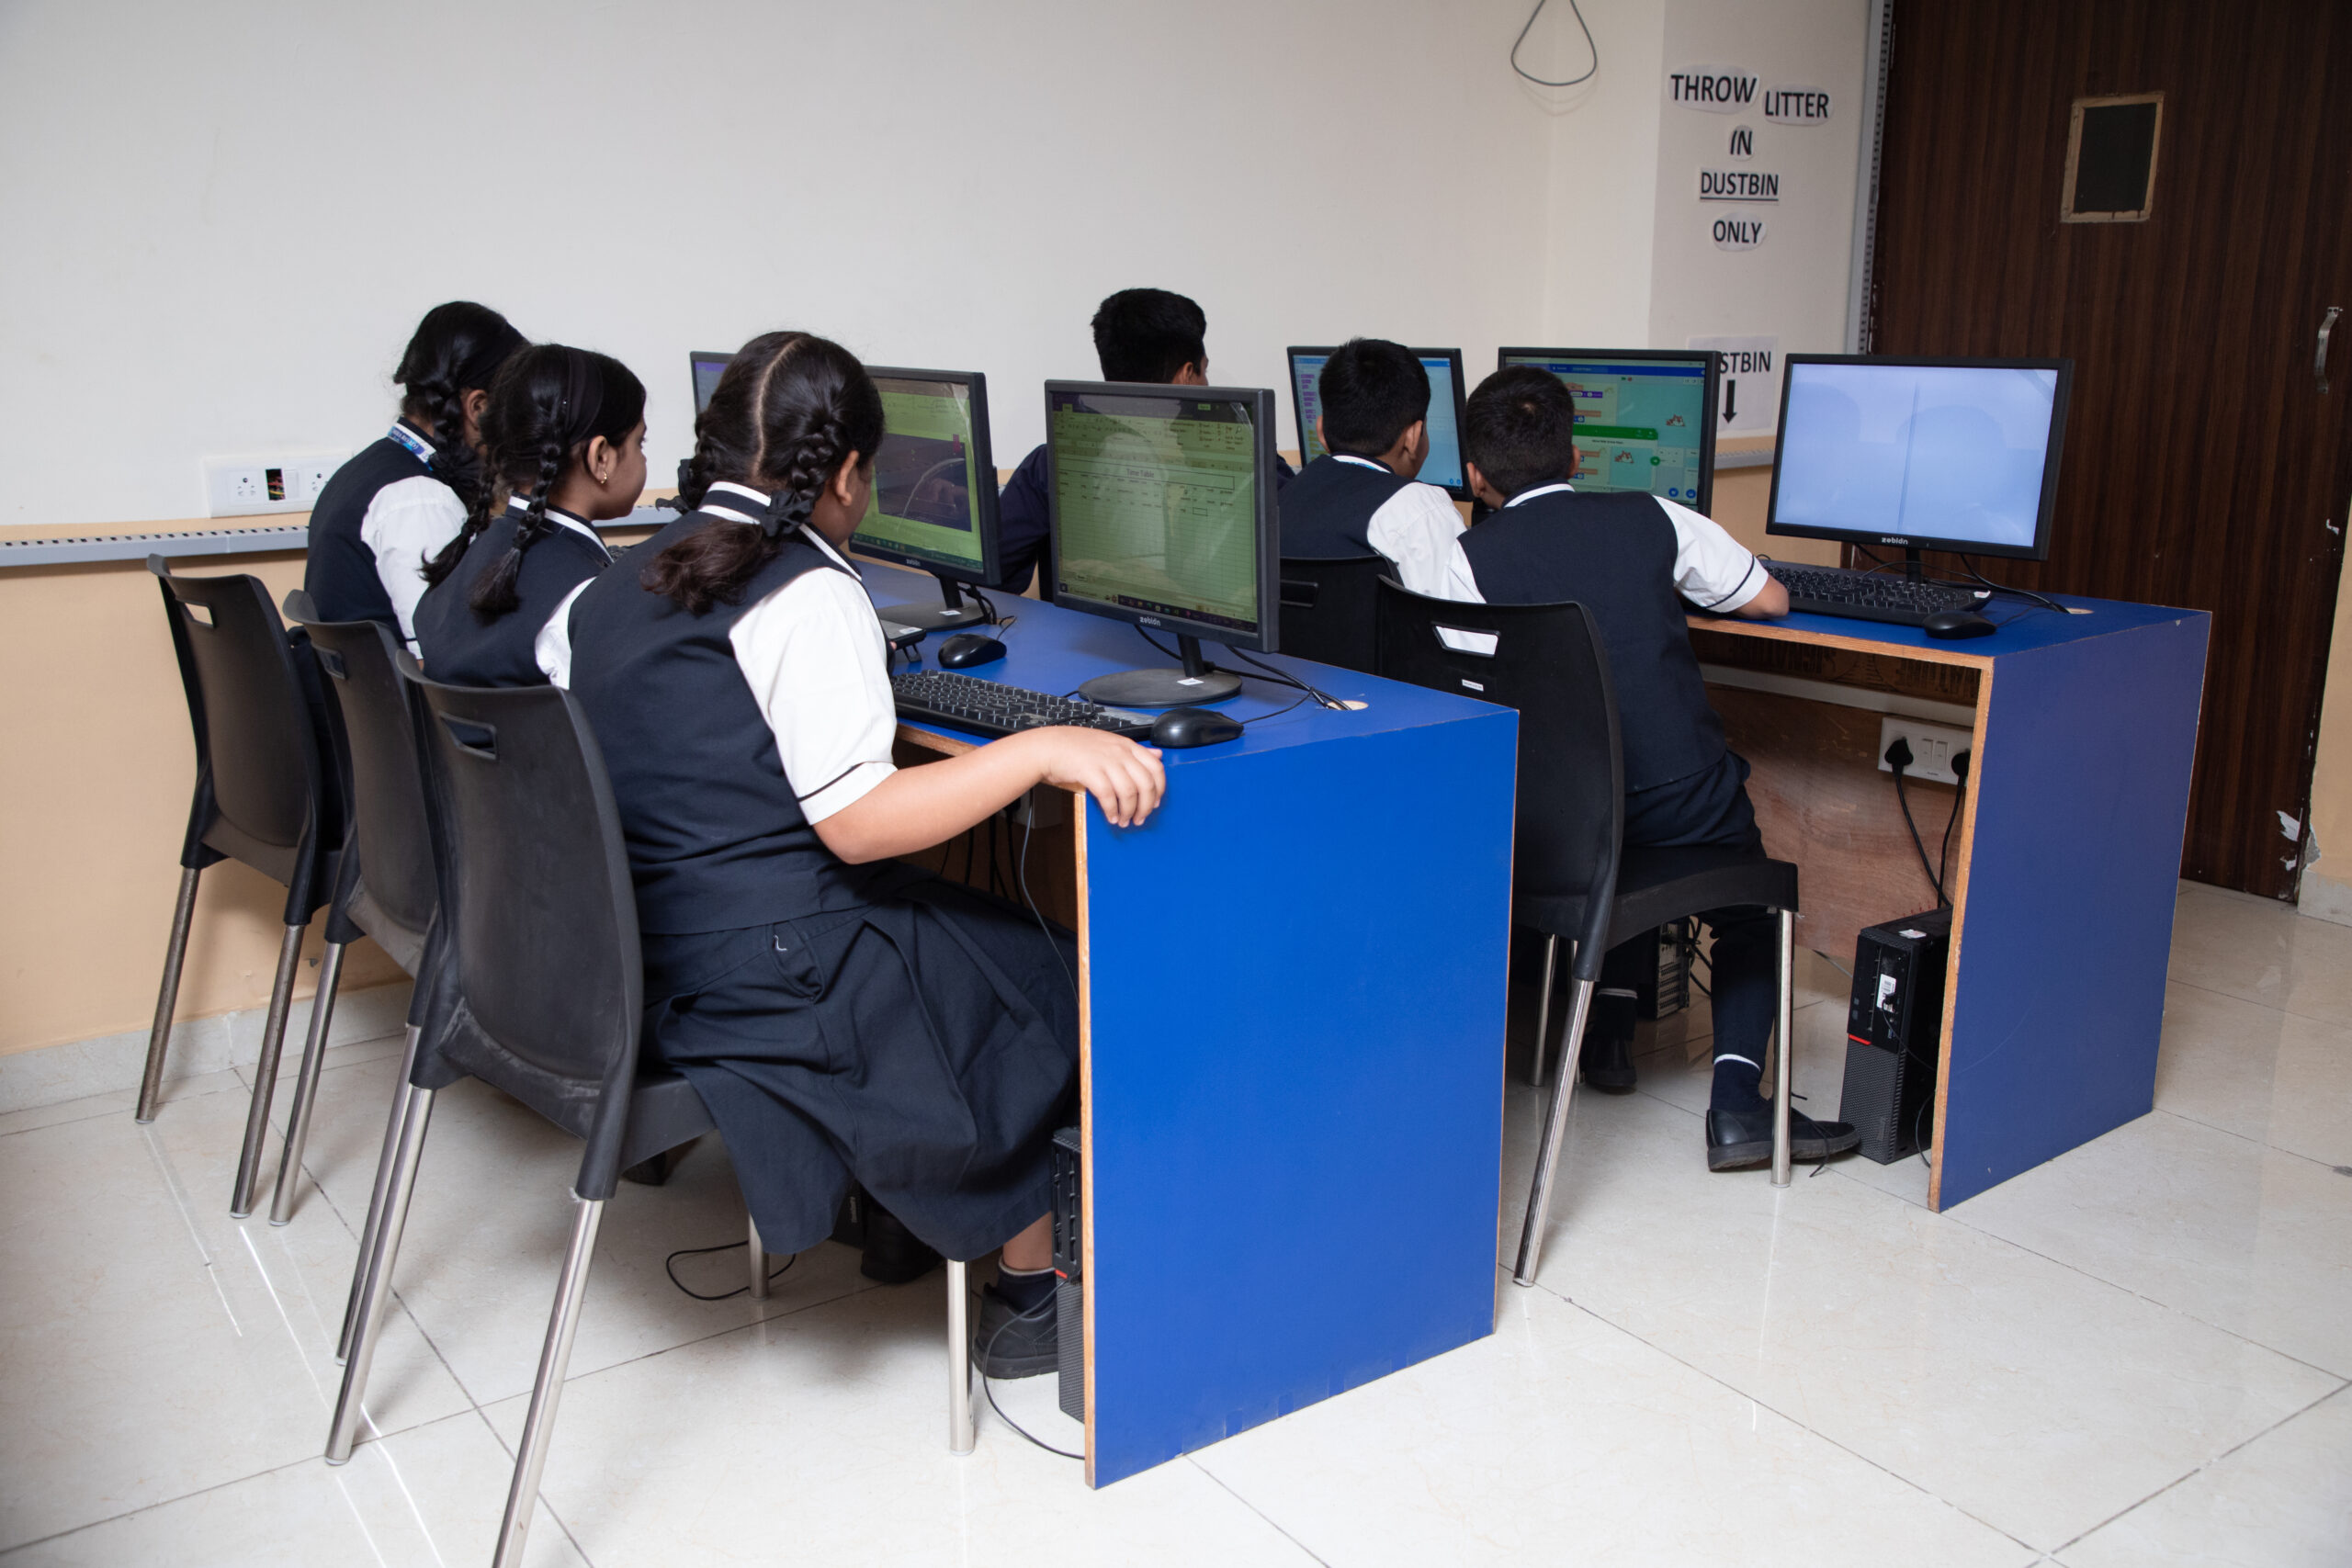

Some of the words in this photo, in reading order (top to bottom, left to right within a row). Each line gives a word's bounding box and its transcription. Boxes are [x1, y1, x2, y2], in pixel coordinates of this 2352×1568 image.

[1670, 74, 1757, 103] THROW
[1765, 91, 1829, 118] LITTER
[1730, 130, 1752, 155] IN
[1701, 172, 1779, 196] DUSTBIN
[1713, 220, 1762, 243] ONLY
[1720, 351, 1771, 374] STBIN
